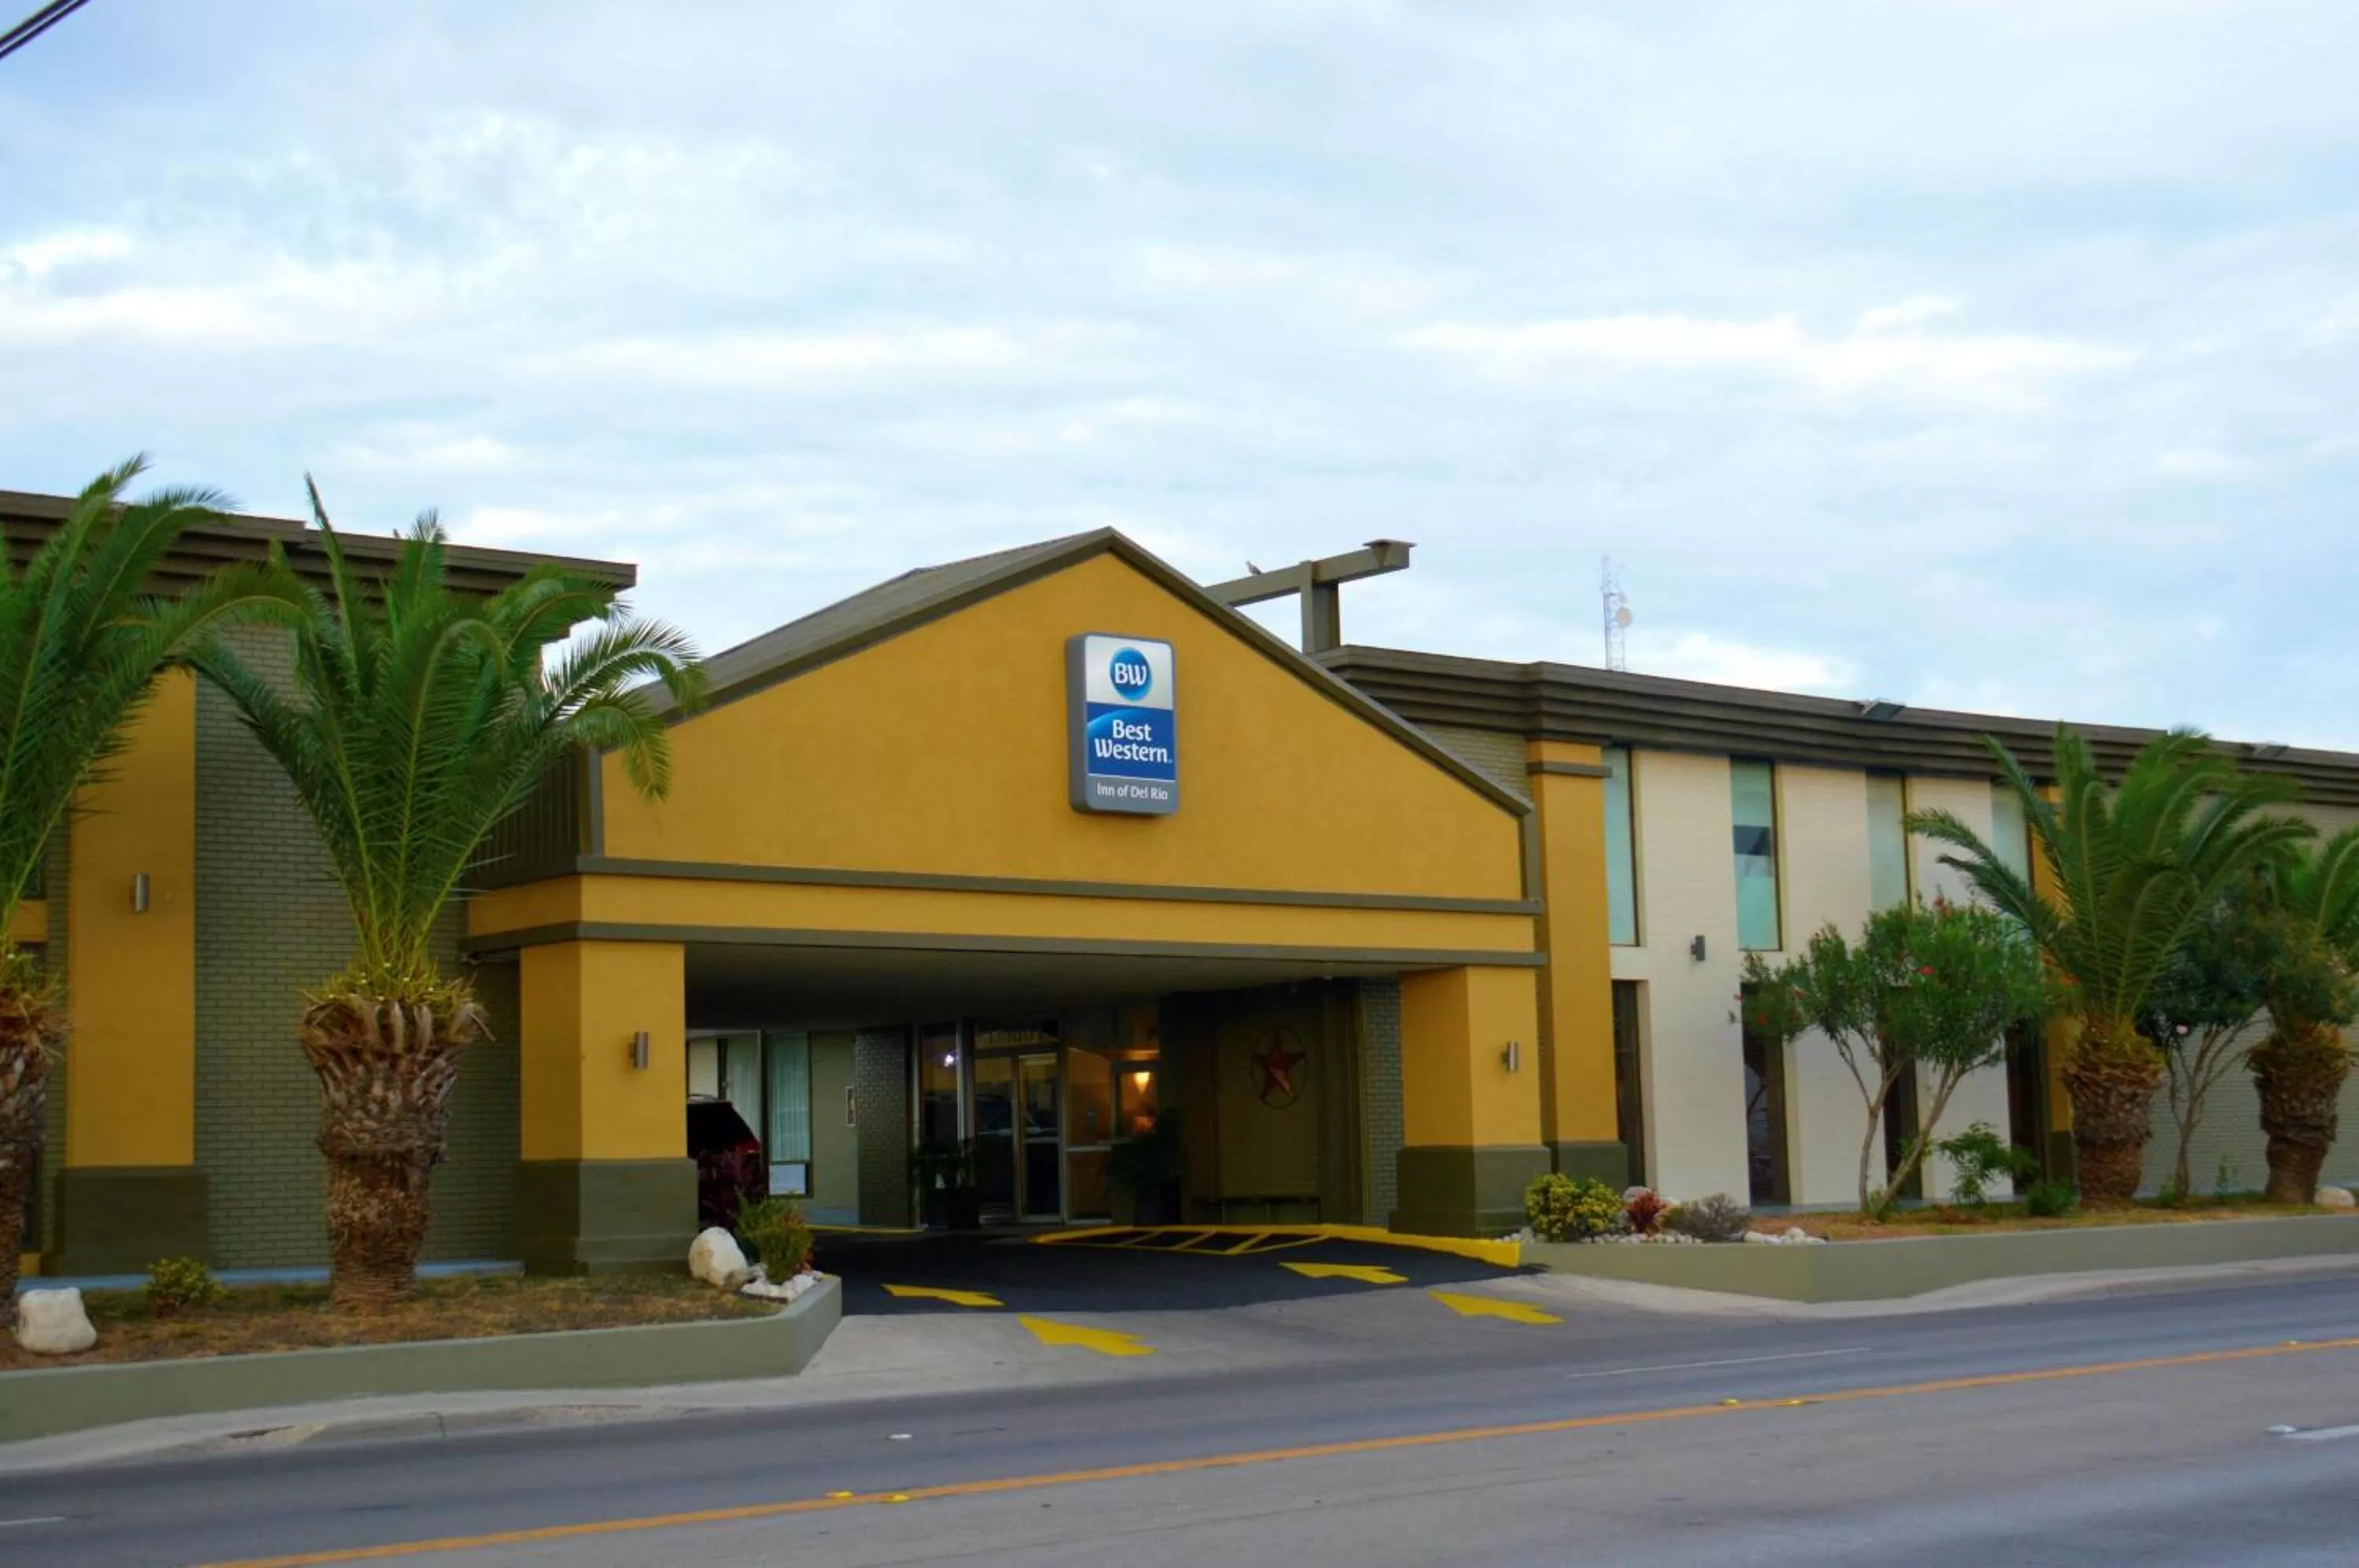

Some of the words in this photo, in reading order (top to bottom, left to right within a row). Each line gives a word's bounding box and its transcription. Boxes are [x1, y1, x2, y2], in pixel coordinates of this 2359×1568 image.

[1114, 662, 1146, 686] BW
[1113, 719, 1152, 742] Best
[1095, 738, 1168, 764] Western
[1097, 783, 1115, 797] Inn
[1117, 785, 1128, 797] of
[1131, 786, 1148, 798] Del
[1150, 786, 1168, 800] Rio
